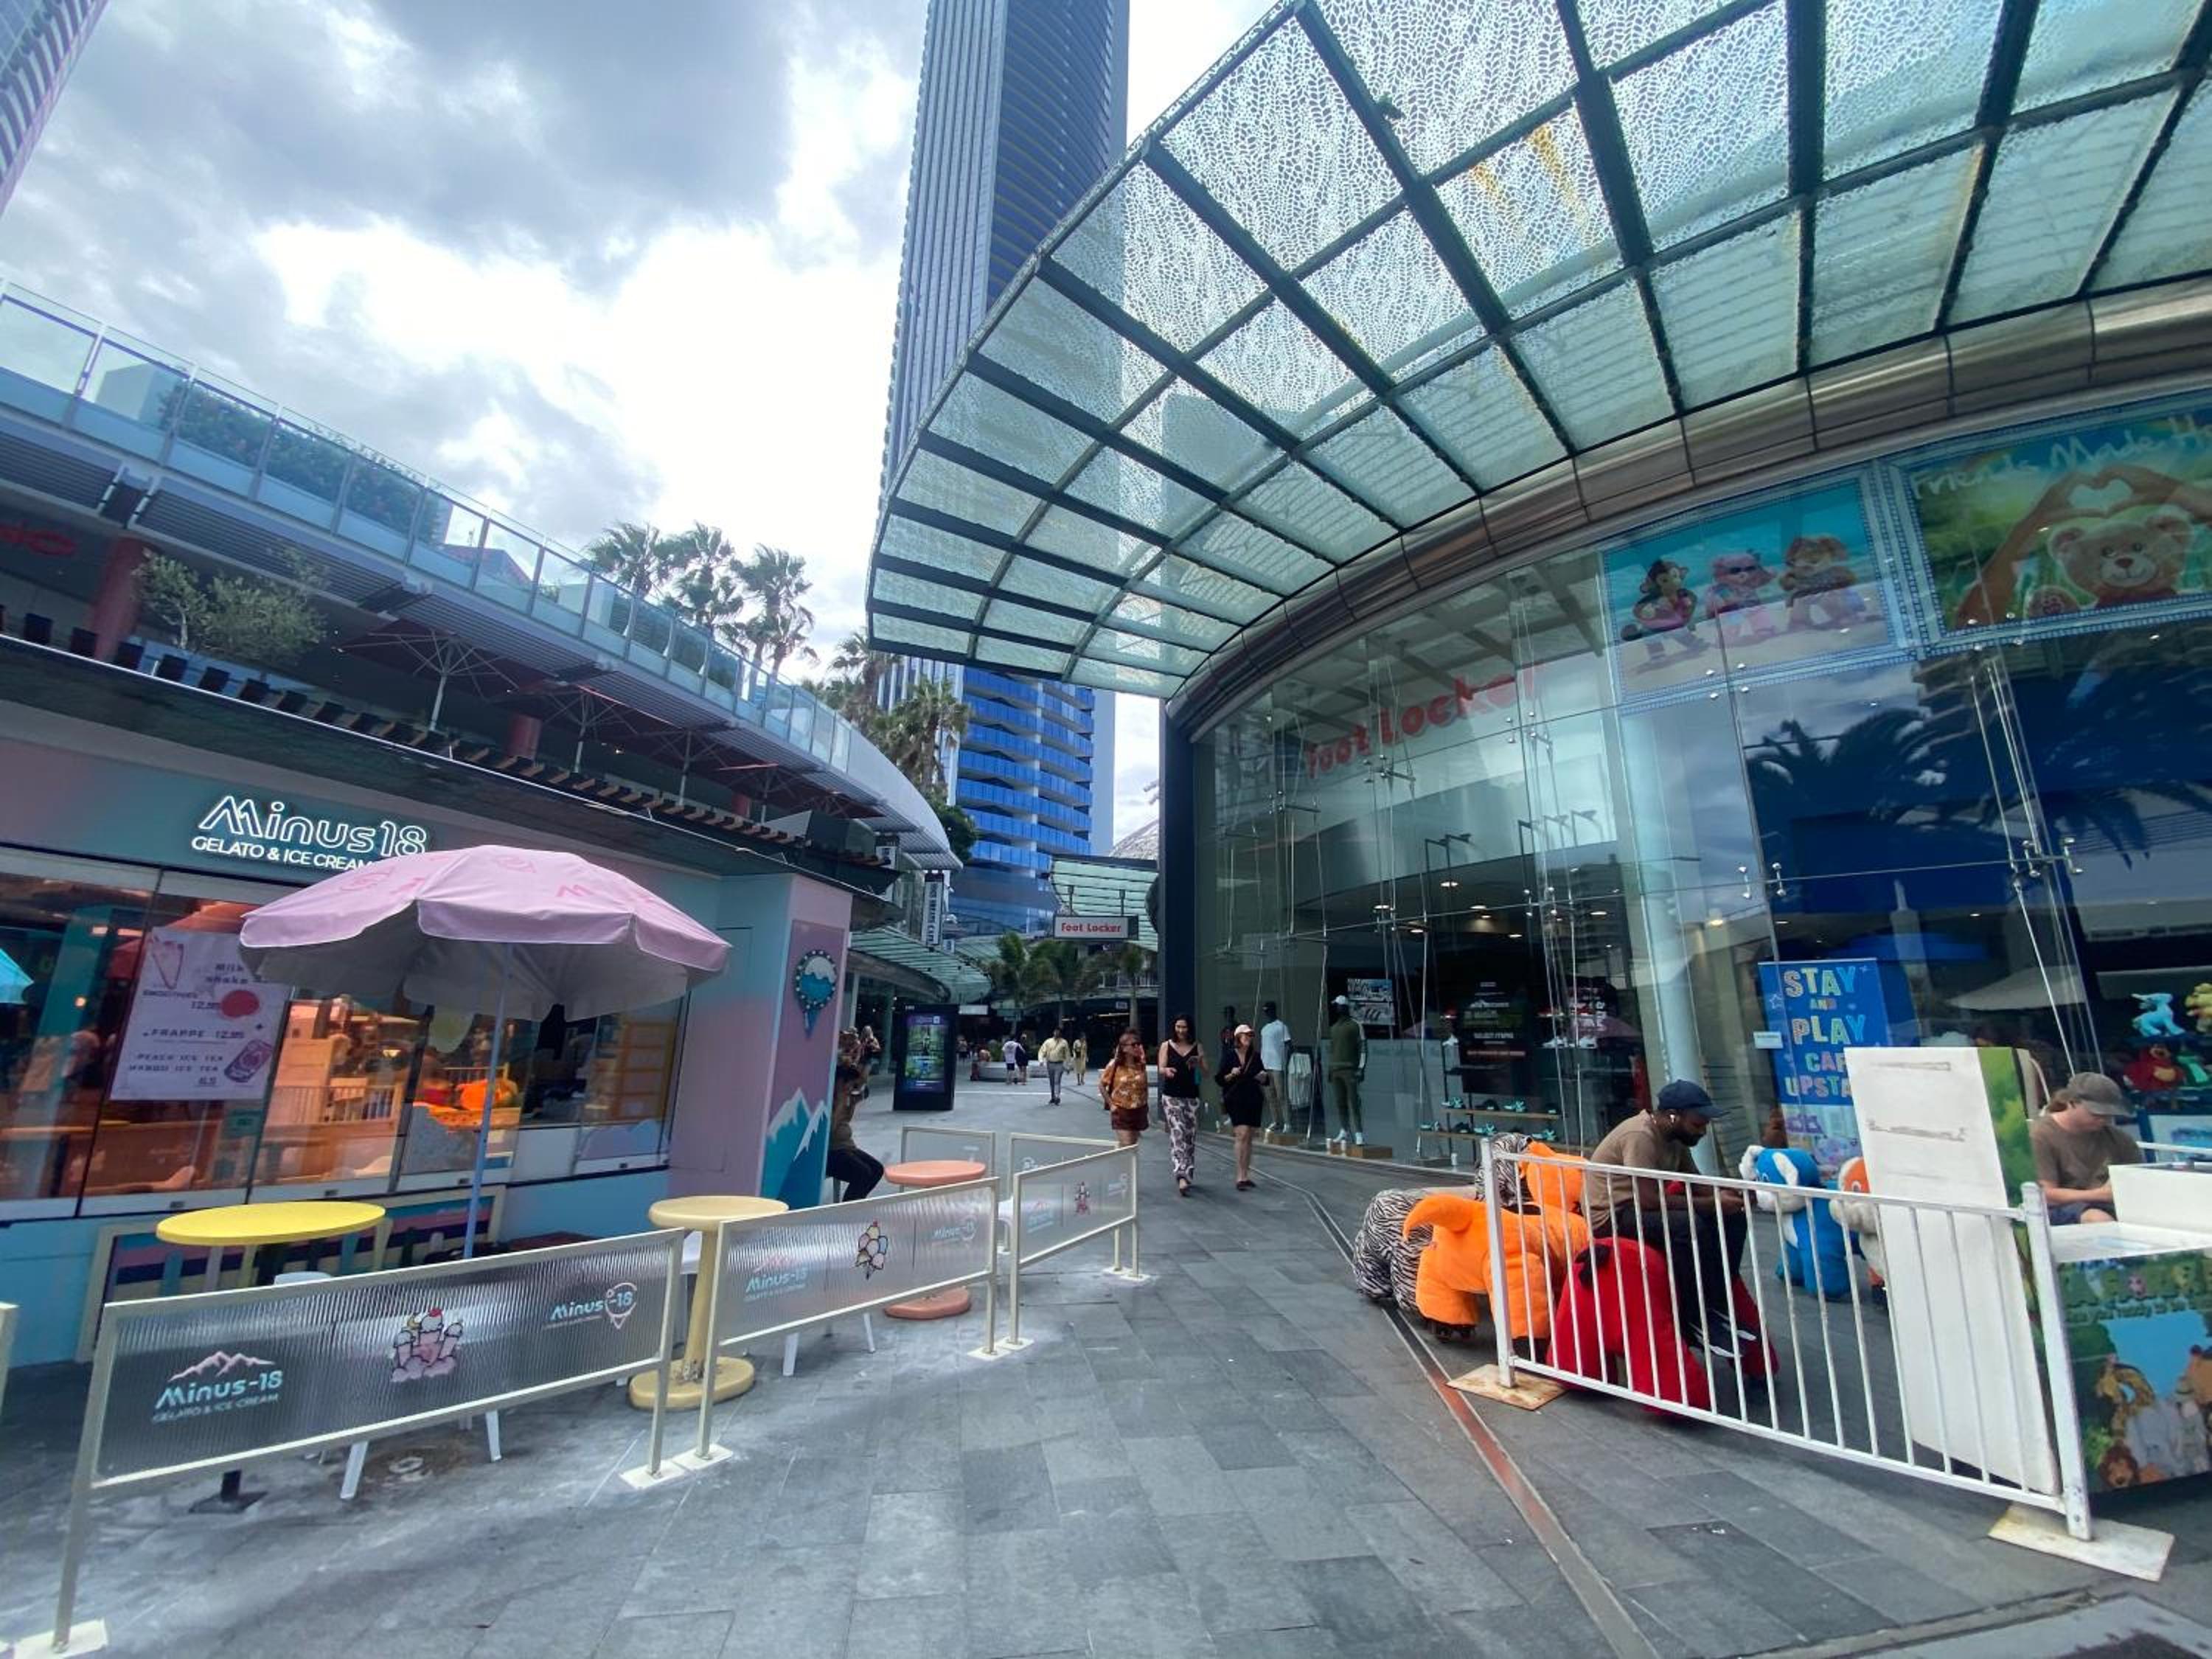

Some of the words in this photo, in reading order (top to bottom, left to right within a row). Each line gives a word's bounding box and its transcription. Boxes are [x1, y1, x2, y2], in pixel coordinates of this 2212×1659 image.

[2049, 429, 2160, 470] Made
[1305, 724, 1370, 779] Foot
[191, 835, 265, 858] GELATO
[267, 847, 279, 861] &
[284, 849, 313, 866] ICE
[313, 853, 373, 871] CREAM
[1062, 922, 1083, 932] Foot
[1087, 922, 1121, 933] Locker
[1783, 966, 1857, 998] STAY
[1809, 998, 1838, 1010] AND
[151, 1029, 205, 1038] FRAPPE
[1791, 1014, 1866, 1045] PLAY
[154, 1369, 284, 1410] Minus-18
